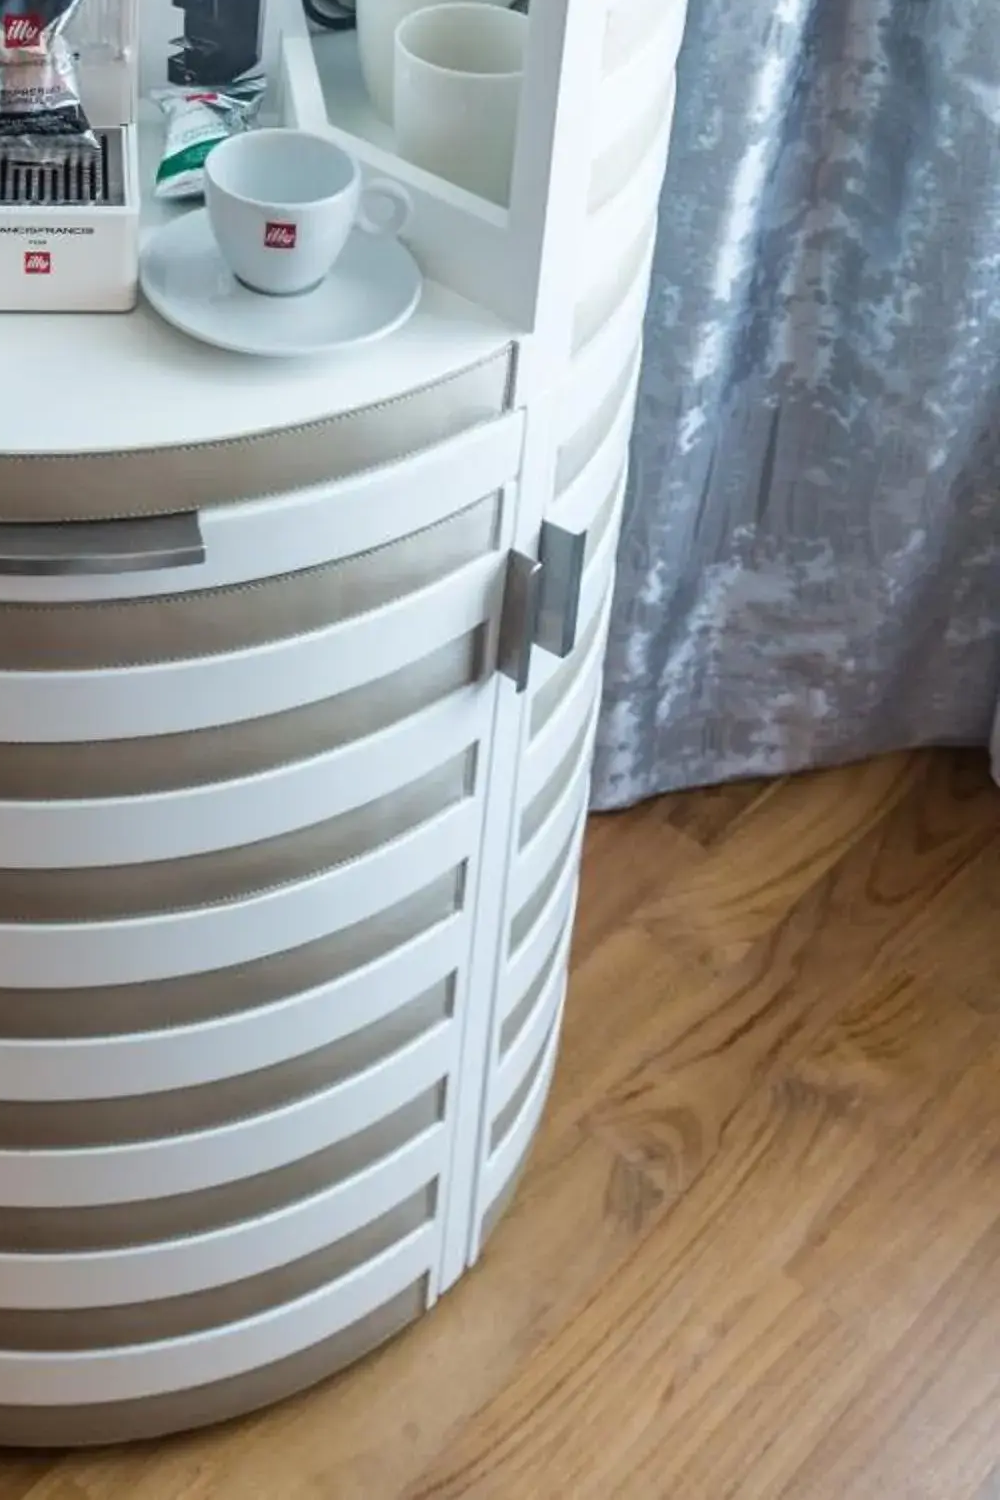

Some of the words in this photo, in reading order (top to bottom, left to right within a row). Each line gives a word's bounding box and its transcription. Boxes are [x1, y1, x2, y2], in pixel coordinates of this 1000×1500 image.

[7, 19, 40, 46] illy
[266, 226, 295, 246] illy
[26, 254, 50, 271] illy
